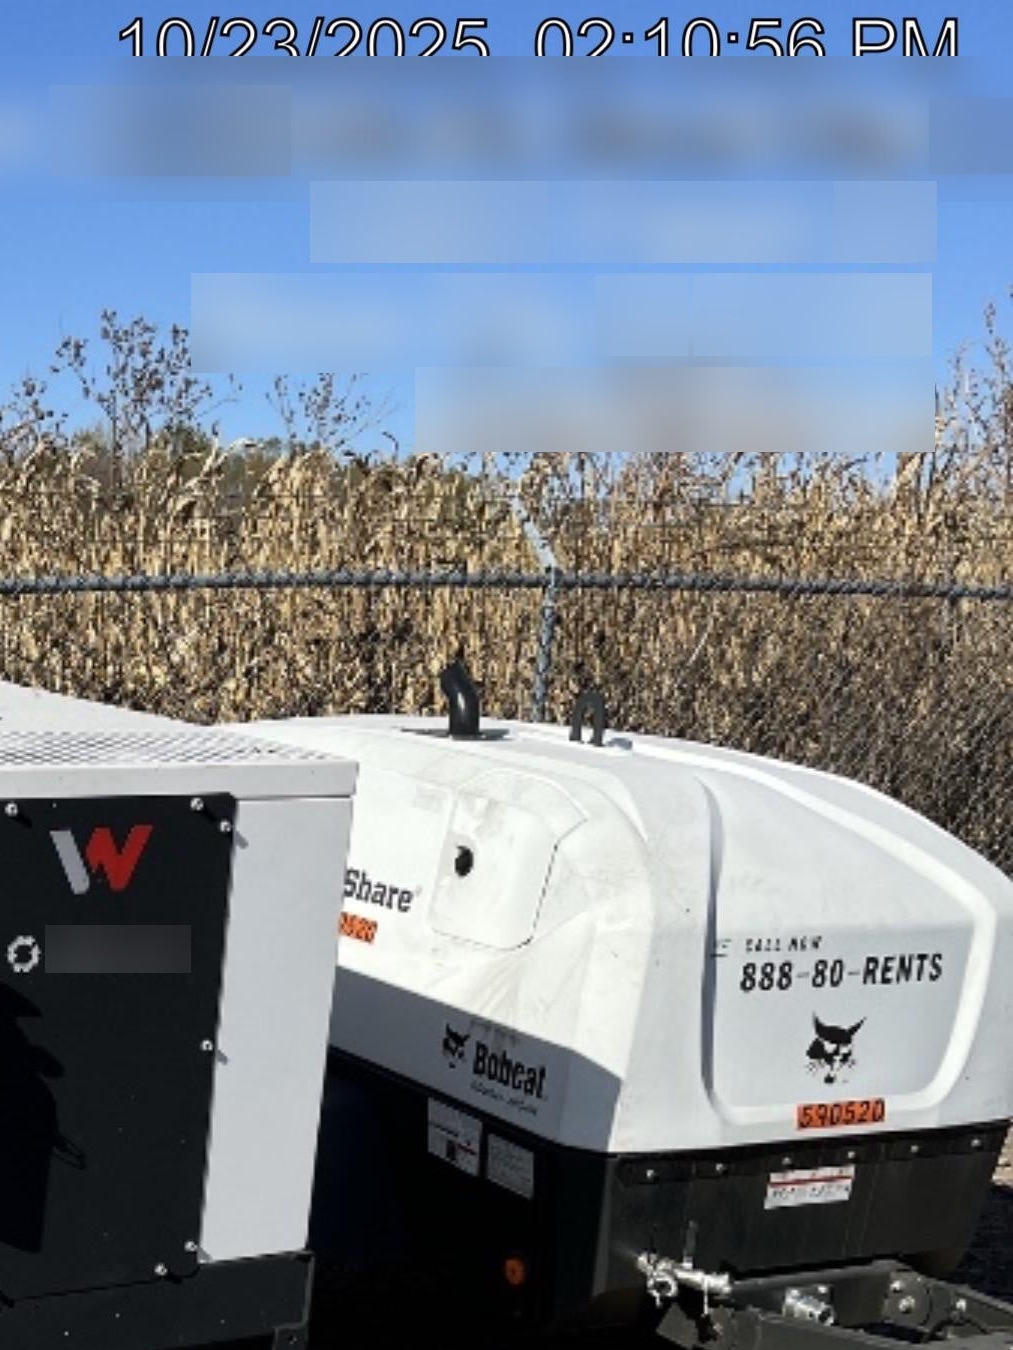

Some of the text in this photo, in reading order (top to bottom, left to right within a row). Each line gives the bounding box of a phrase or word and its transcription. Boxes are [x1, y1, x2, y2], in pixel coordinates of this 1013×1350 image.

[739, 953, 944, 993] 888-80-RENTS
[473, 1040, 546, 1099] Bobcat
[798, 1099, 885, 1128] 590520
